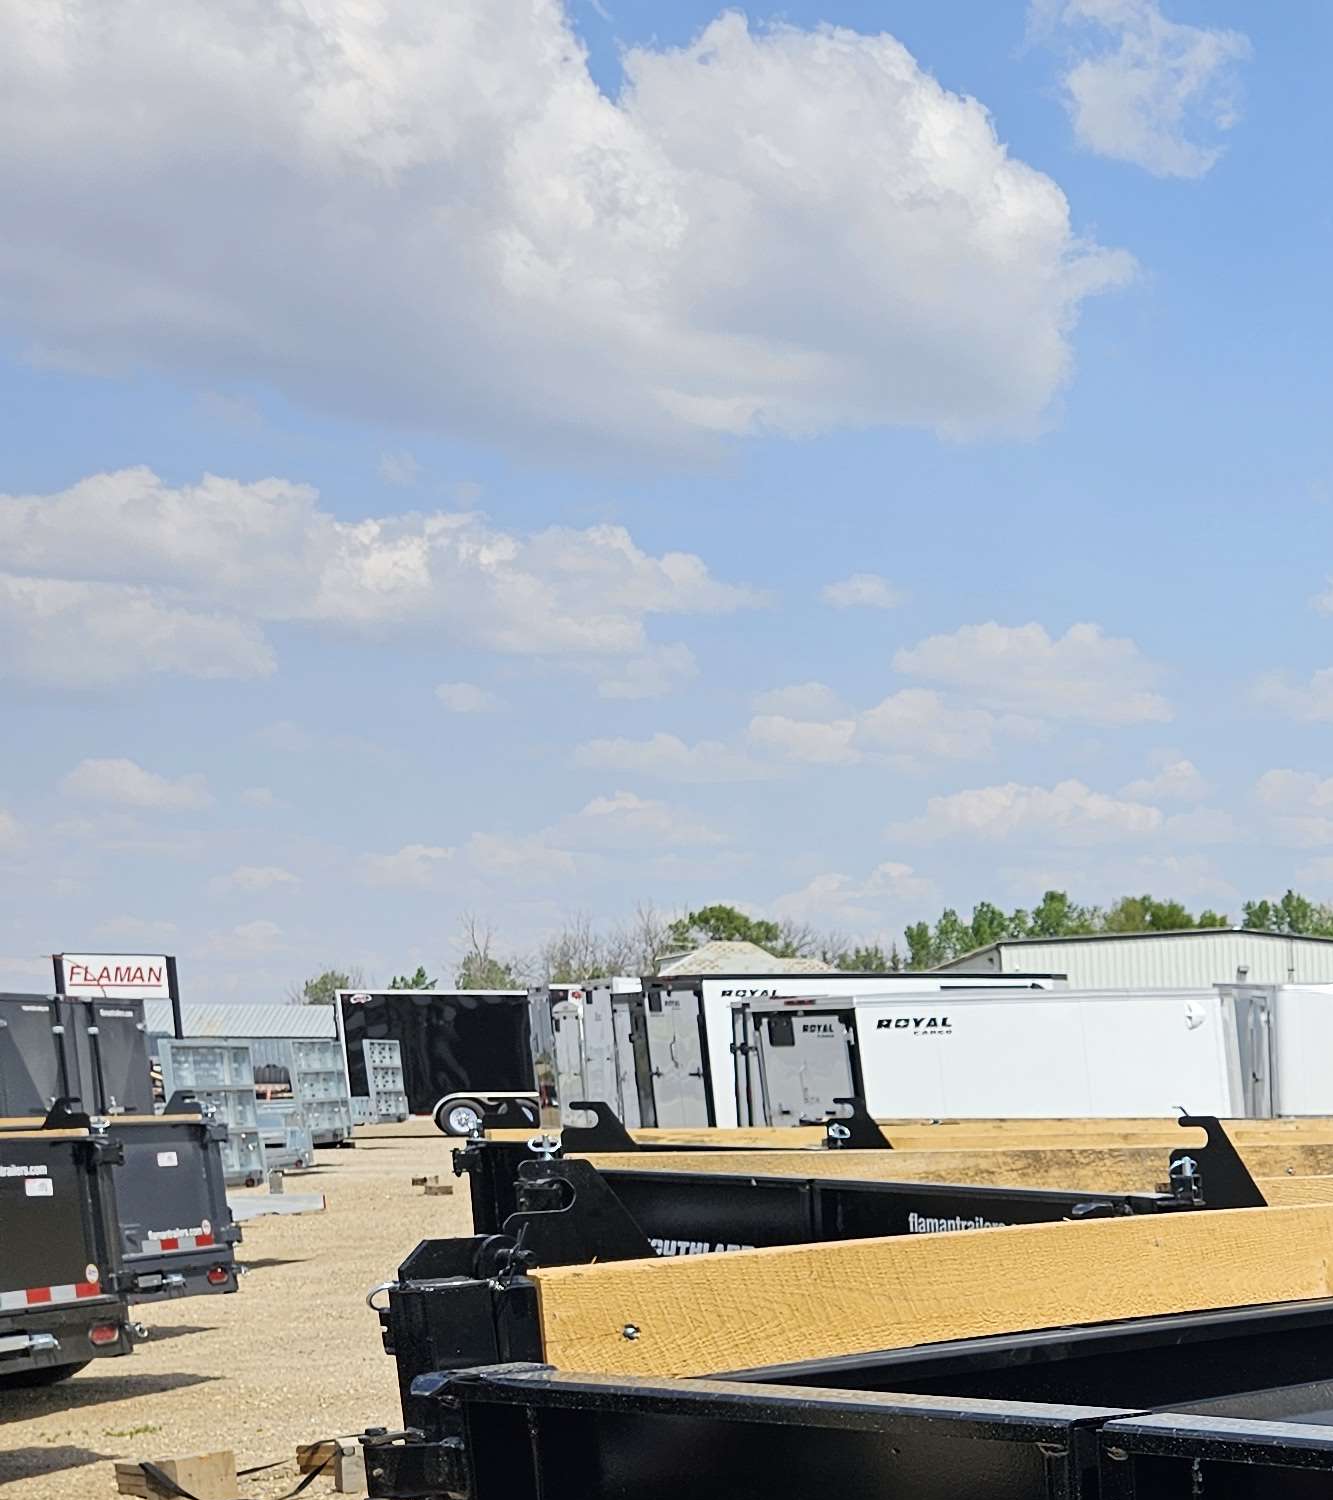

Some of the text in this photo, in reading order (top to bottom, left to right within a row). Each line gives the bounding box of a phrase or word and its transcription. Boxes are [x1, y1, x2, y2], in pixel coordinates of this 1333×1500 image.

[69, 966, 163, 982] FLAMAN
[802, 1023, 834, 1032] ROYAL
[876, 1017, 952, 1029] ROYAL
